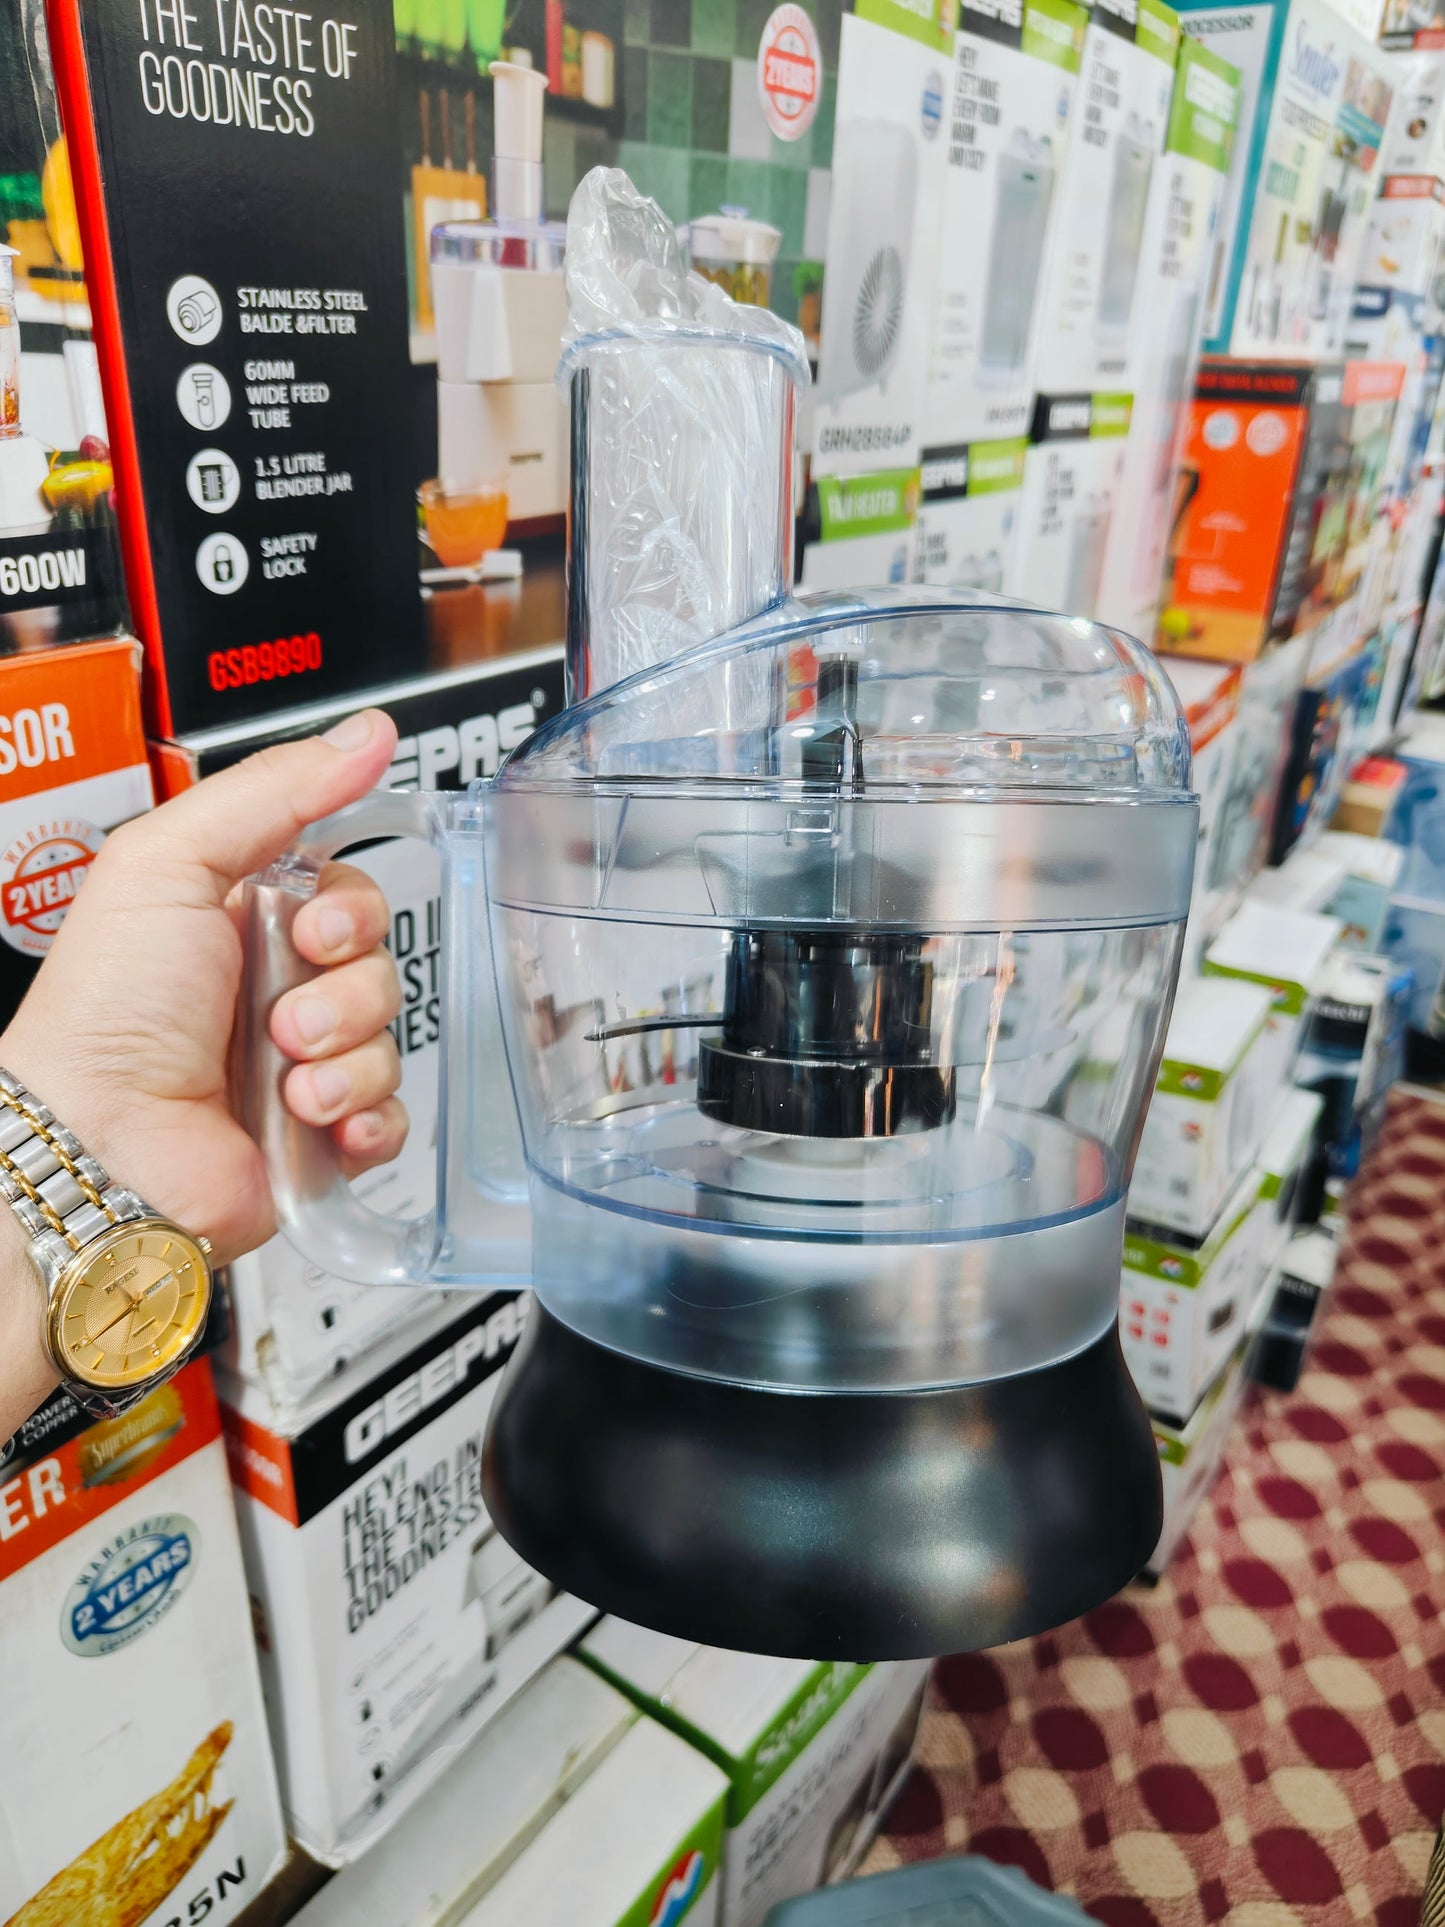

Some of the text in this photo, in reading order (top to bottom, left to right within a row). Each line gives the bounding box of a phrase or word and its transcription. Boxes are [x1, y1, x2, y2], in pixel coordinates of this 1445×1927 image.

[138, 0, 358, 79] THE TASTE OF
[139, 51, 315, 137] GOODNESS
[237, 287, 368, 311] STAINLESS STEEL
[240, 313, 293, 333] BALDE
[244, 360, 295, 381] 60MM
[245, 383, 330, 405] WIDE FEED
[248, 407, 291, 429] TUBE
[255, 452, 326, 477] 1.5 LITRE
[255, 471, 353, 500] BLENDER JAR
[260, 532, 318, 558] SAFETY
[263, 557, 307, 580] LOCK
[208, 631, 323, 692] GSB9890
[5, 821, 92, 865] WARRANTY
[20, 1395, 75, 1434] POWER
[22, 1405, 78, 1446] COPPER
[75, 1605, 97, 1634] 2
[97, 1539, 189, 1613] YEARS
[164, 1855, 245, 1927] 5N
